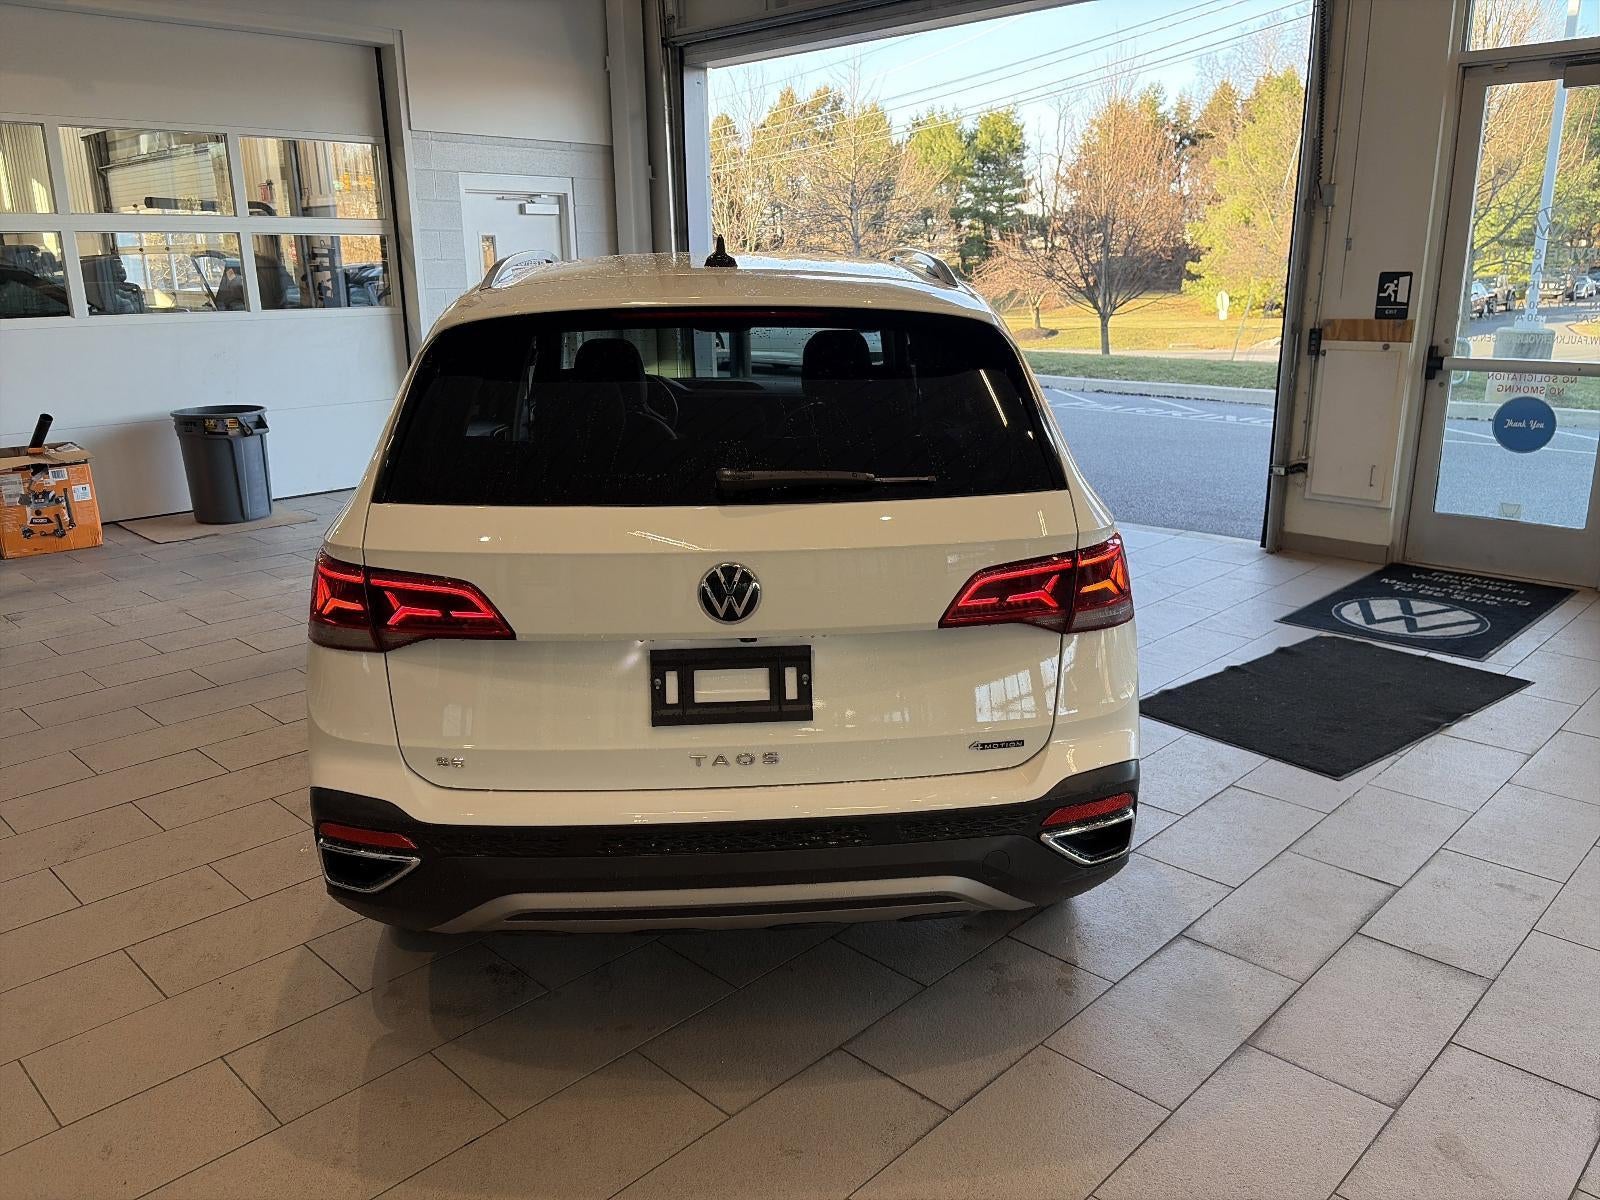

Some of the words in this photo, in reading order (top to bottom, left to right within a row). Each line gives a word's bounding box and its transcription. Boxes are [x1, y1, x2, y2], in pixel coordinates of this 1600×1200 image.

[1504, 418, 1527, 429] Thank
[1529, 419, 1545, 431] You
[969, 740, 1024, 751] 4MOTION
[689, 752, 779, 767] TAOS
